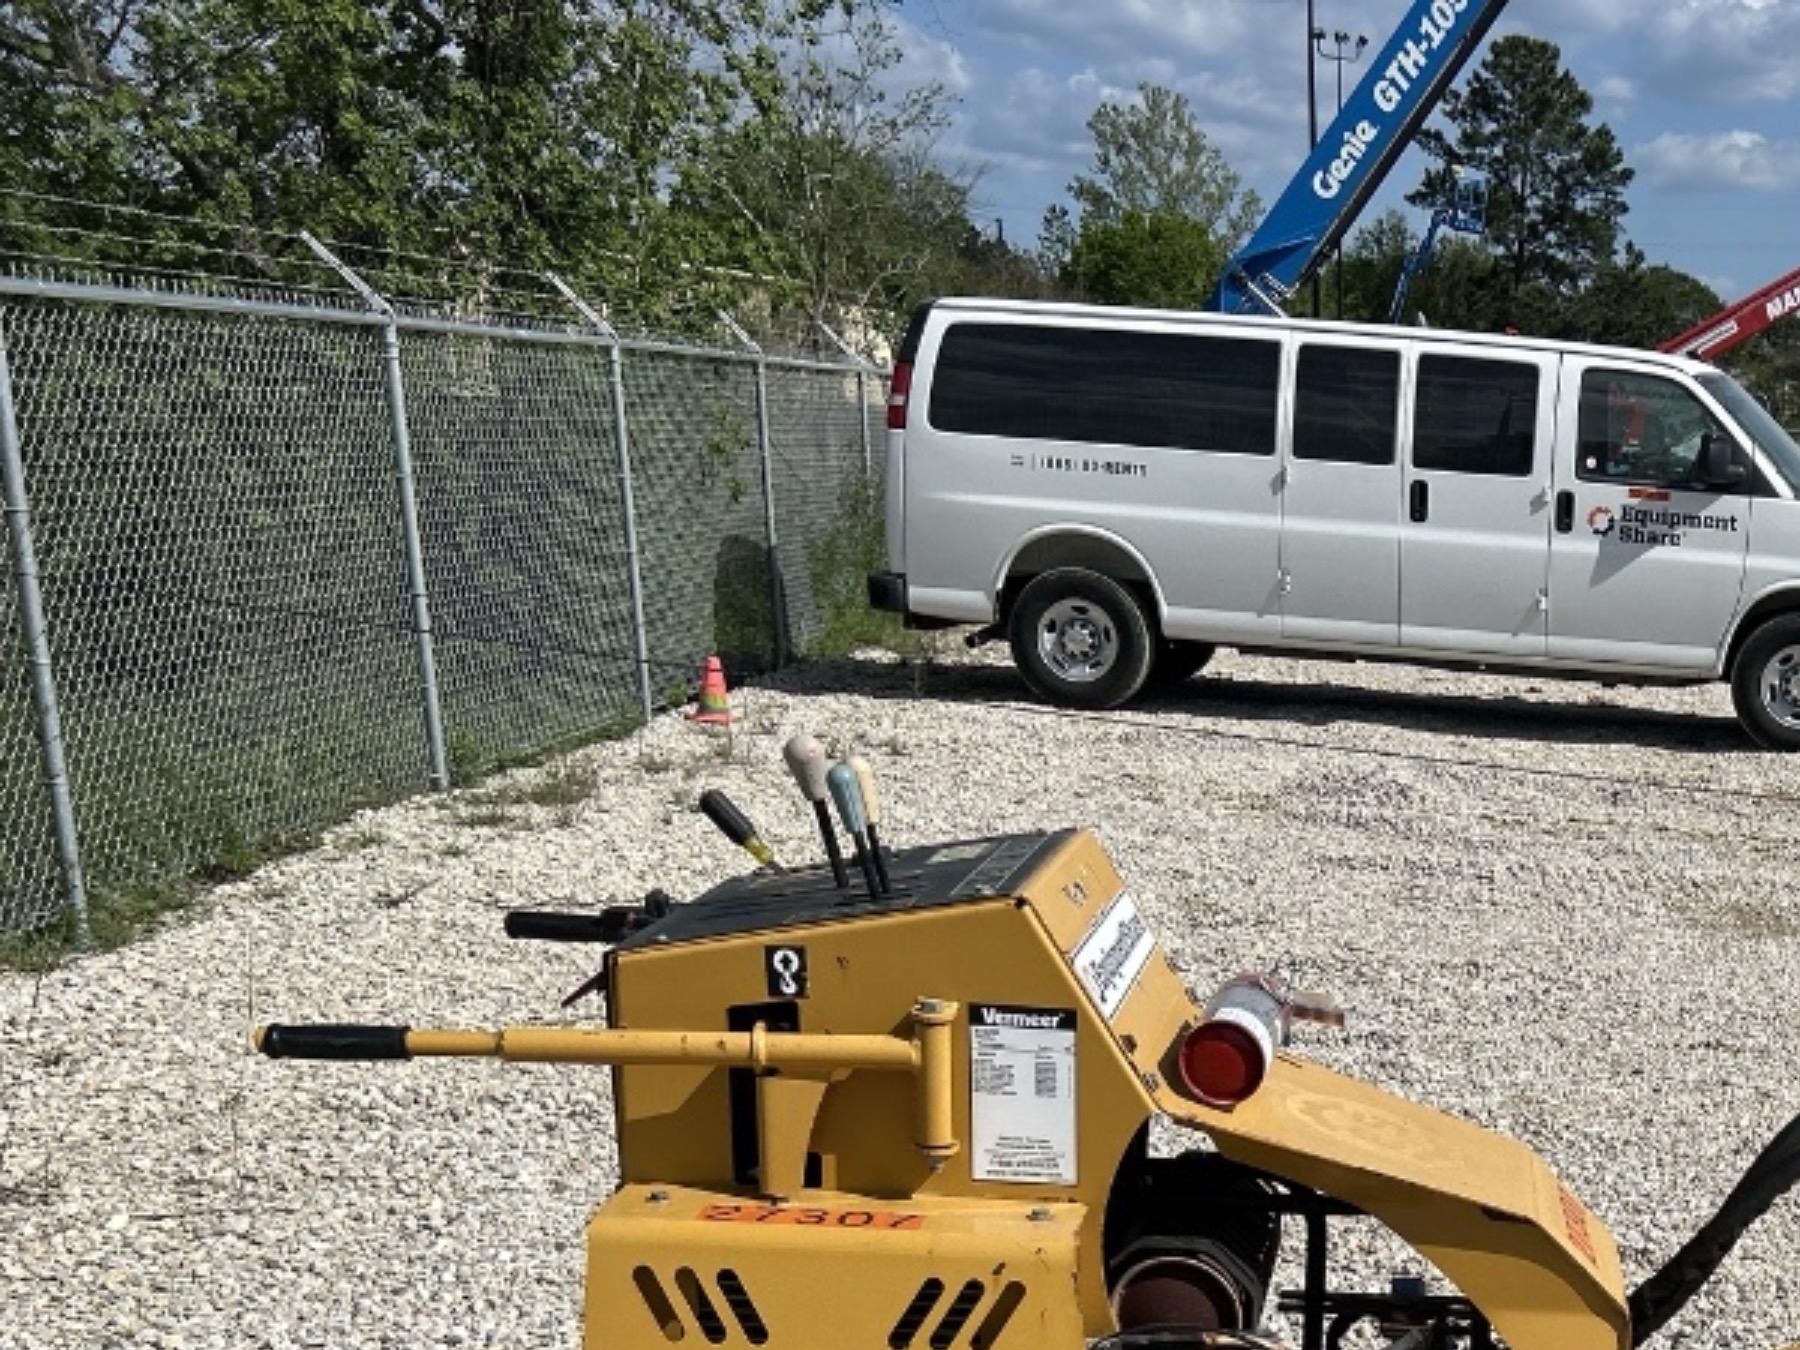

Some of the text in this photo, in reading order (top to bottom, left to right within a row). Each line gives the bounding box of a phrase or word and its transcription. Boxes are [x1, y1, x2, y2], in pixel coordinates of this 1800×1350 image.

[1312, 119, 1381, 199] Genie
[1620, 504, 1738, 532] Equipment
[1618, 525, 1681, 547] Share
[980, 1007, 1061, 1028] Vermeer
[705, 1204, 920, 1229] 27307
